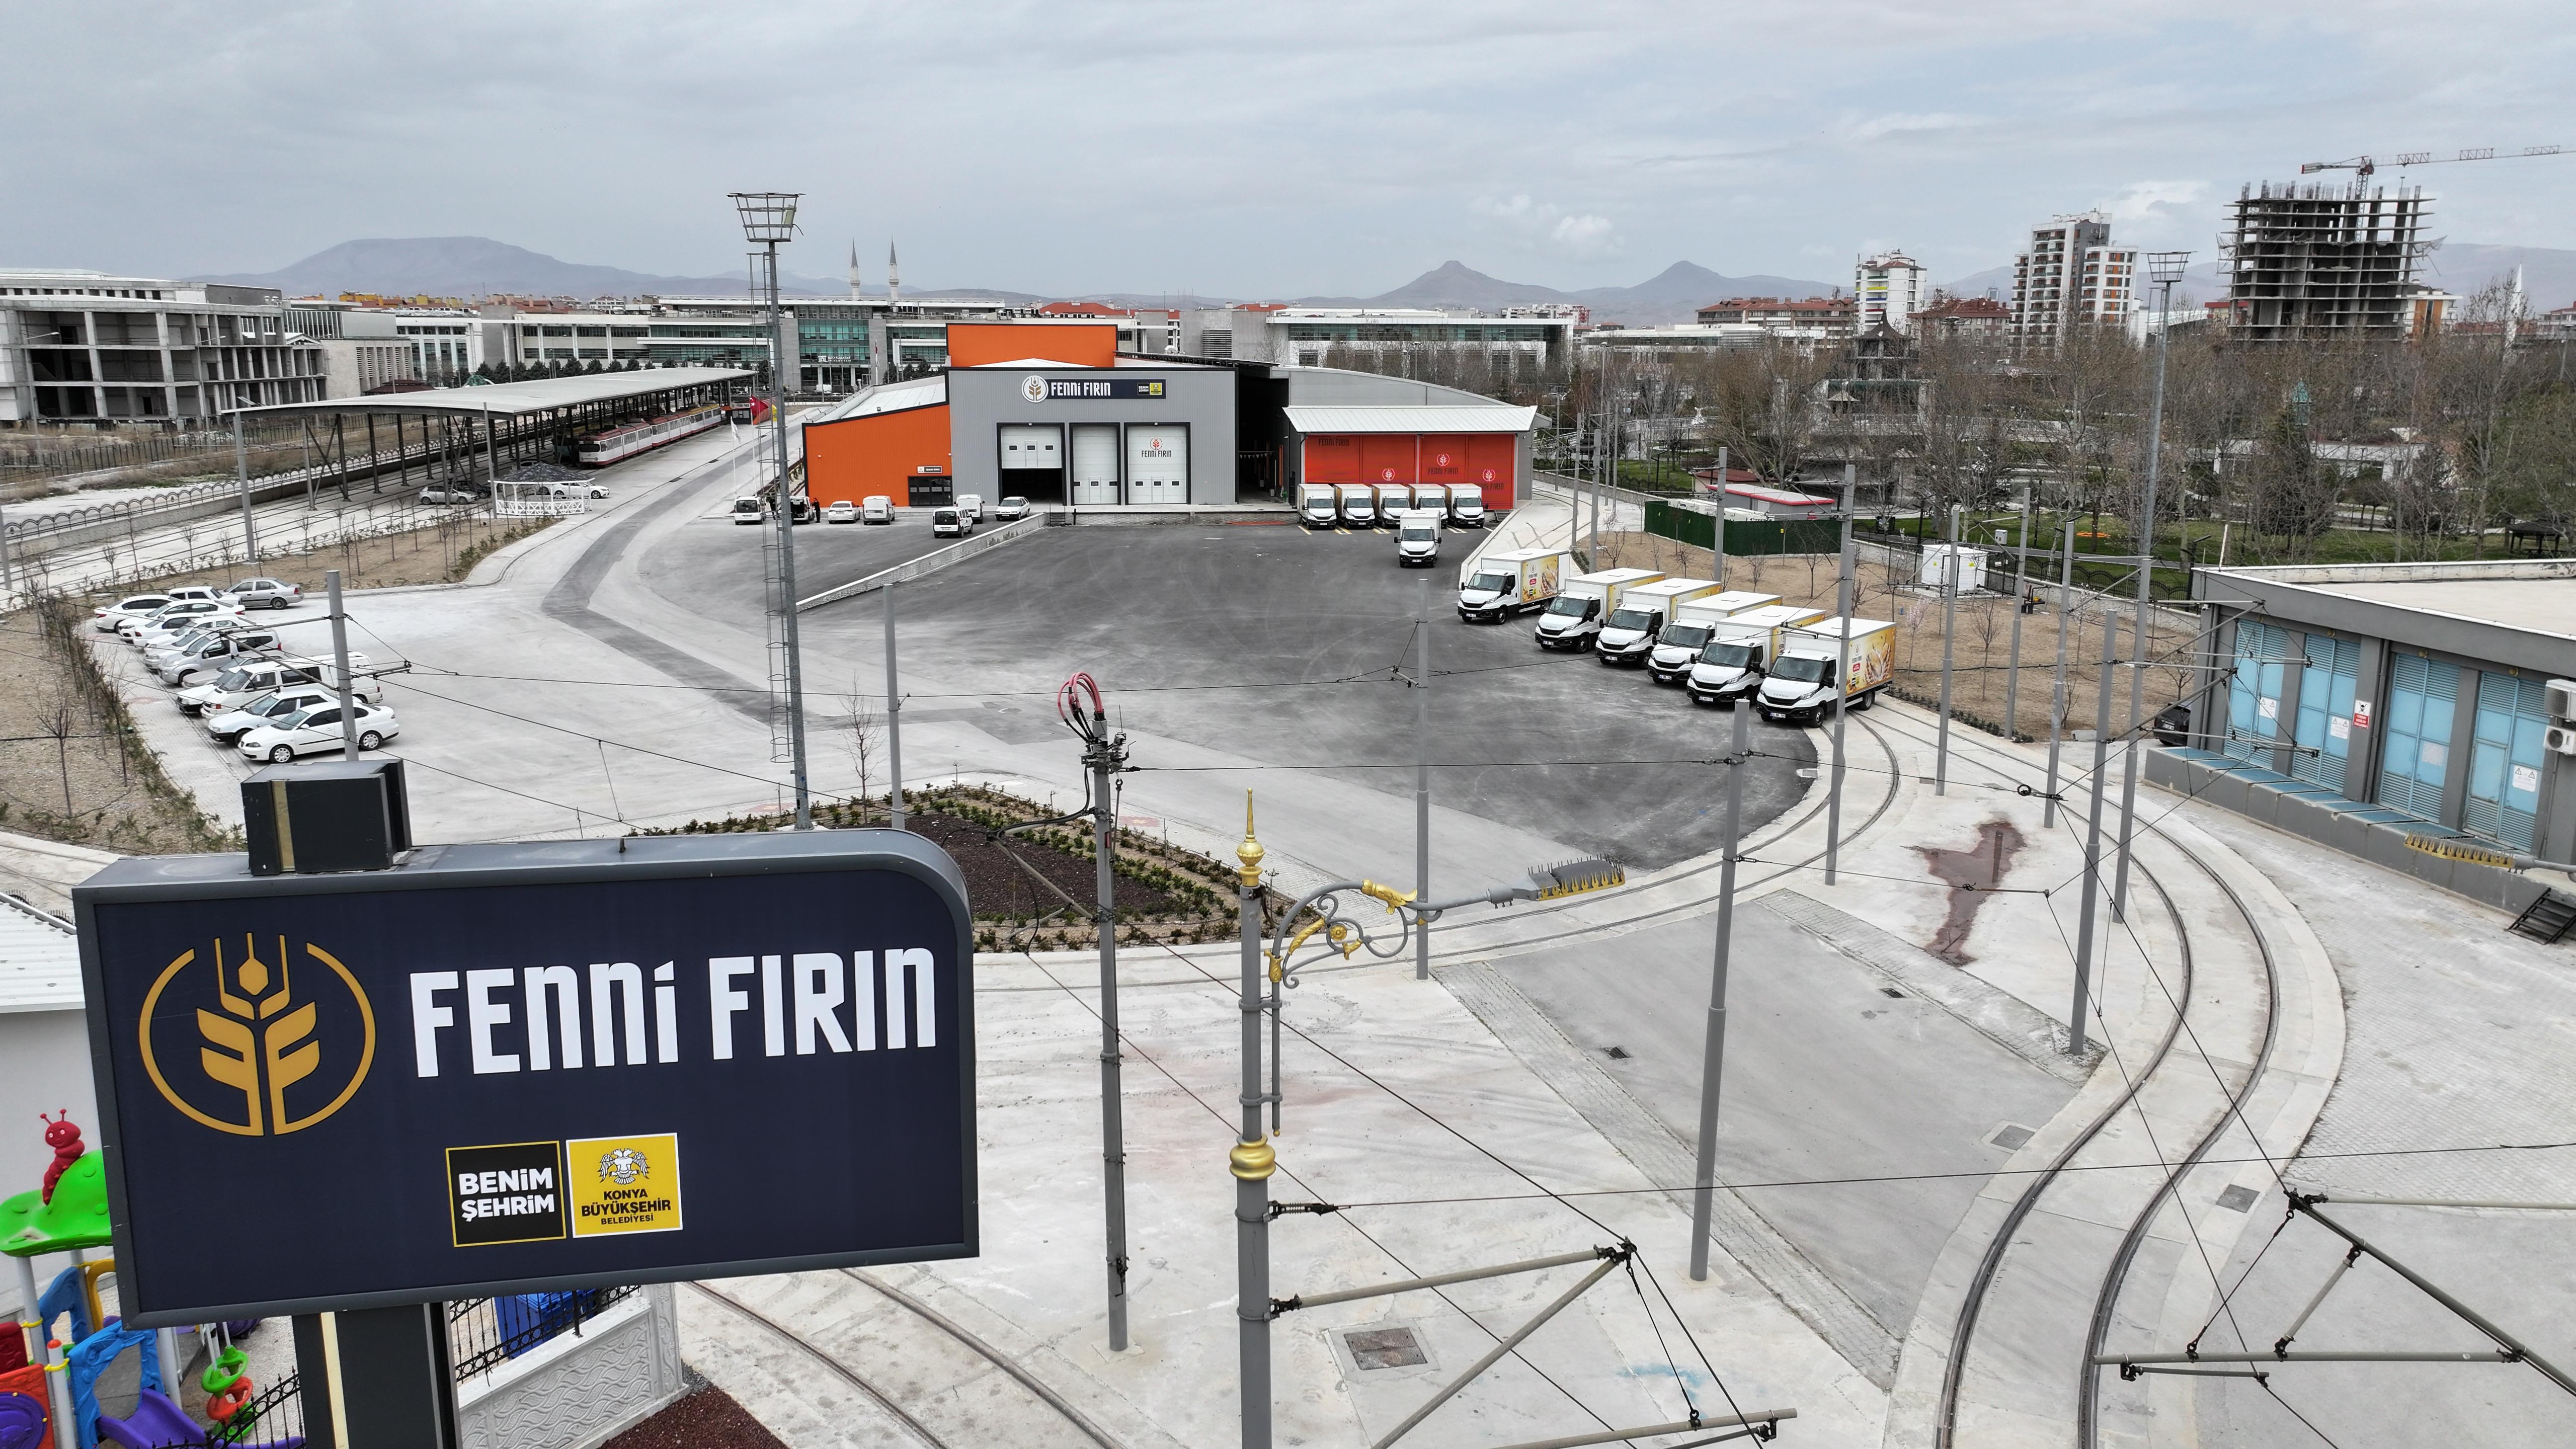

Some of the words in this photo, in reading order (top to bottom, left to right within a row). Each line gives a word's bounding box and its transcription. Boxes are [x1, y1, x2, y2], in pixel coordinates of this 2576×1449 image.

[1084, 382, 1111, 396] FIRIN
[708, 947, 936, 1060] FIRIN
[603, 1188, 648, 1200] KONYA
[581, 1197, 671, 1217] BÜYÜKŞEHİR
[601, 1213, 654, 1225] BELEDİYESİ
